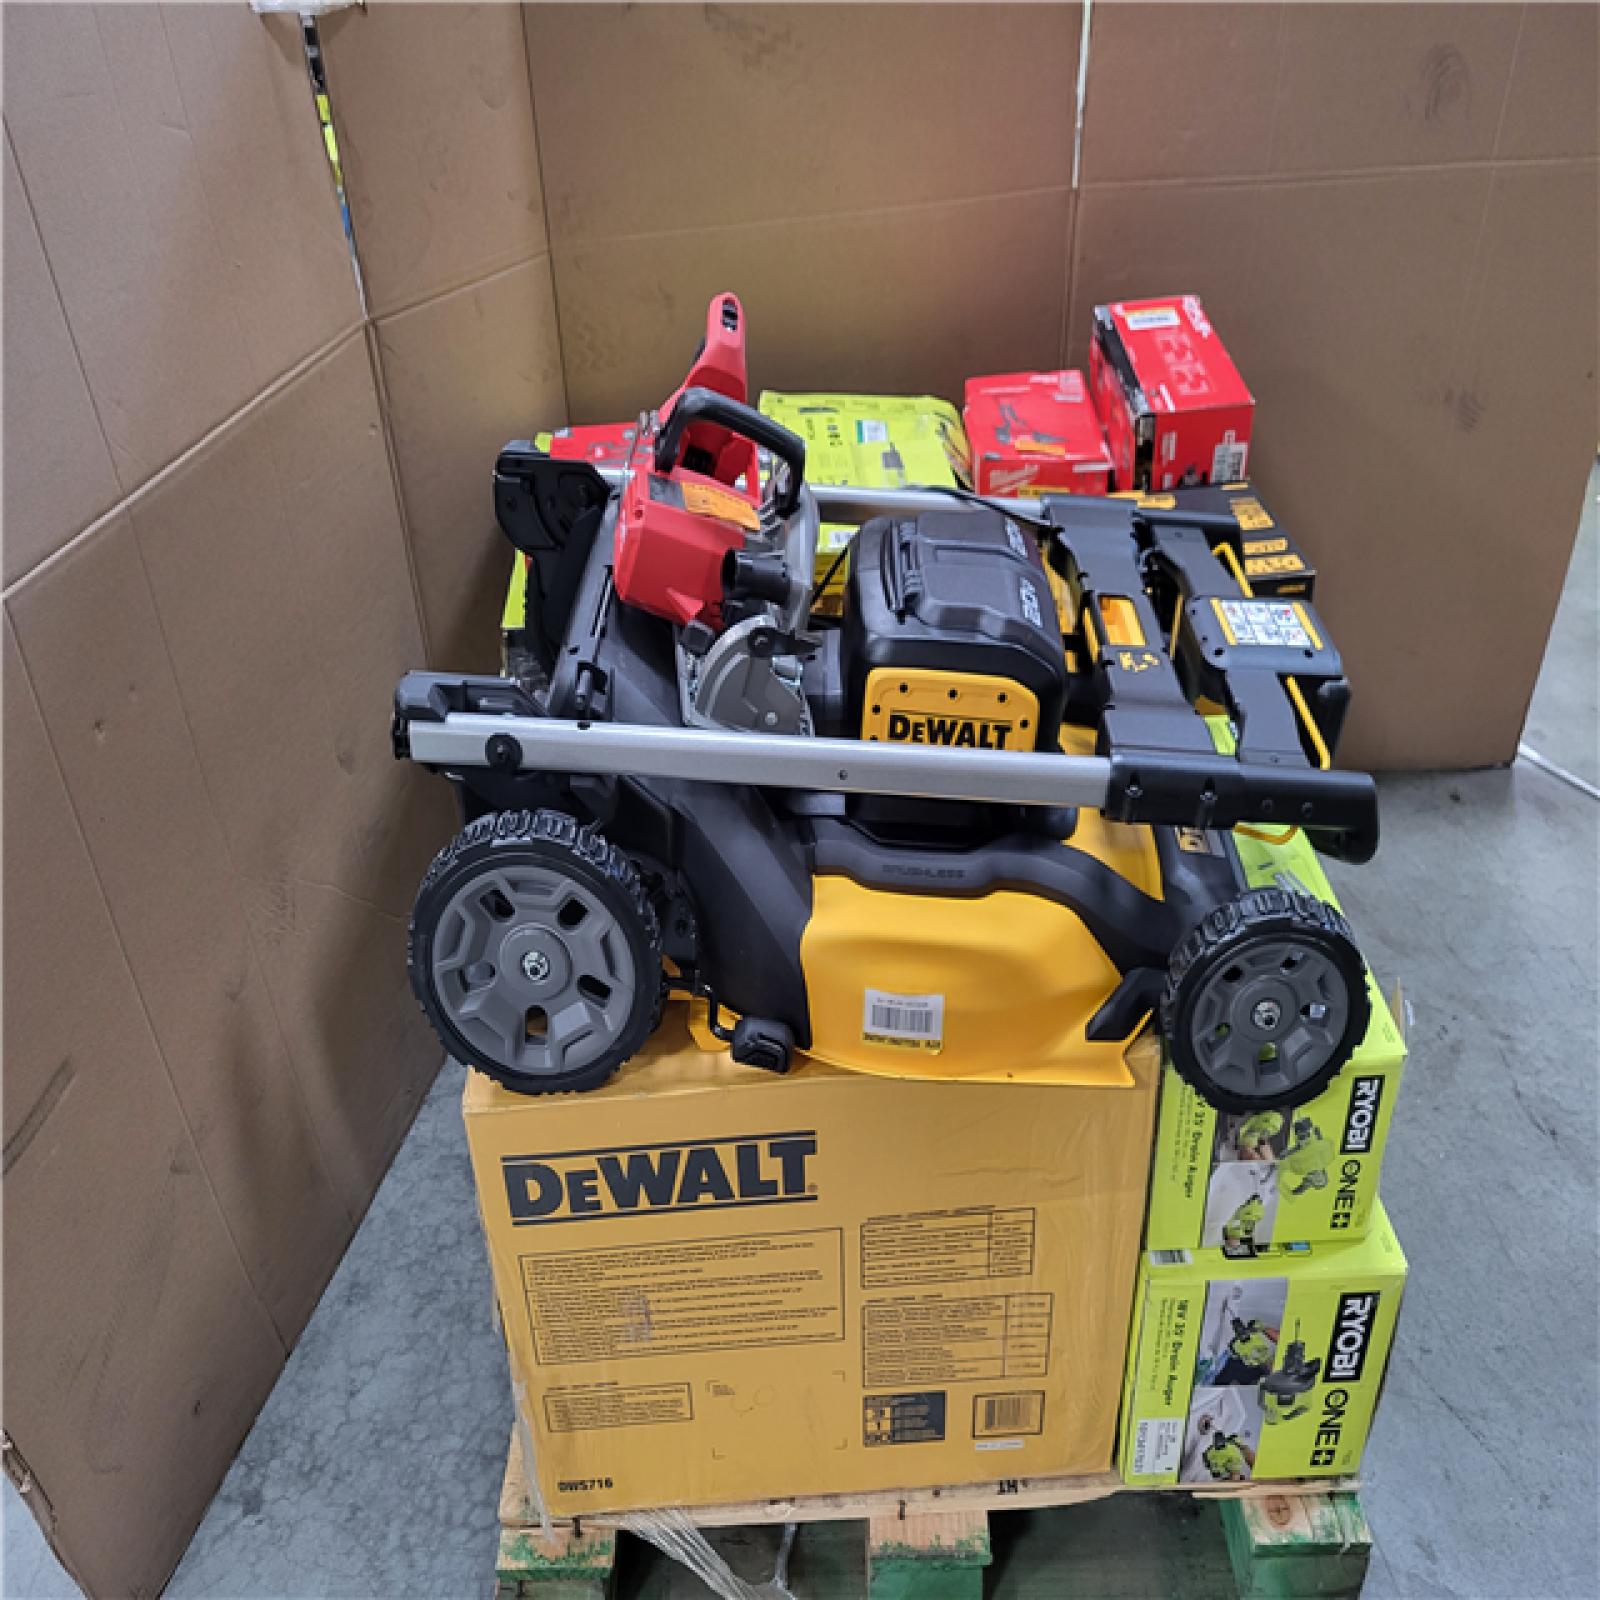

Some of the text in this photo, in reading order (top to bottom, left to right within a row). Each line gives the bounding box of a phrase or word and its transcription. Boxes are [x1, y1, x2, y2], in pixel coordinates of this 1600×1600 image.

[889, 714, 1013, 750] DEWALT
[1345, 1078, 1380, 1150] RYOBI
[502, 1139, 817, 1218] DEWALT
[1329, 1294, 1373, 1378] RYOBI
